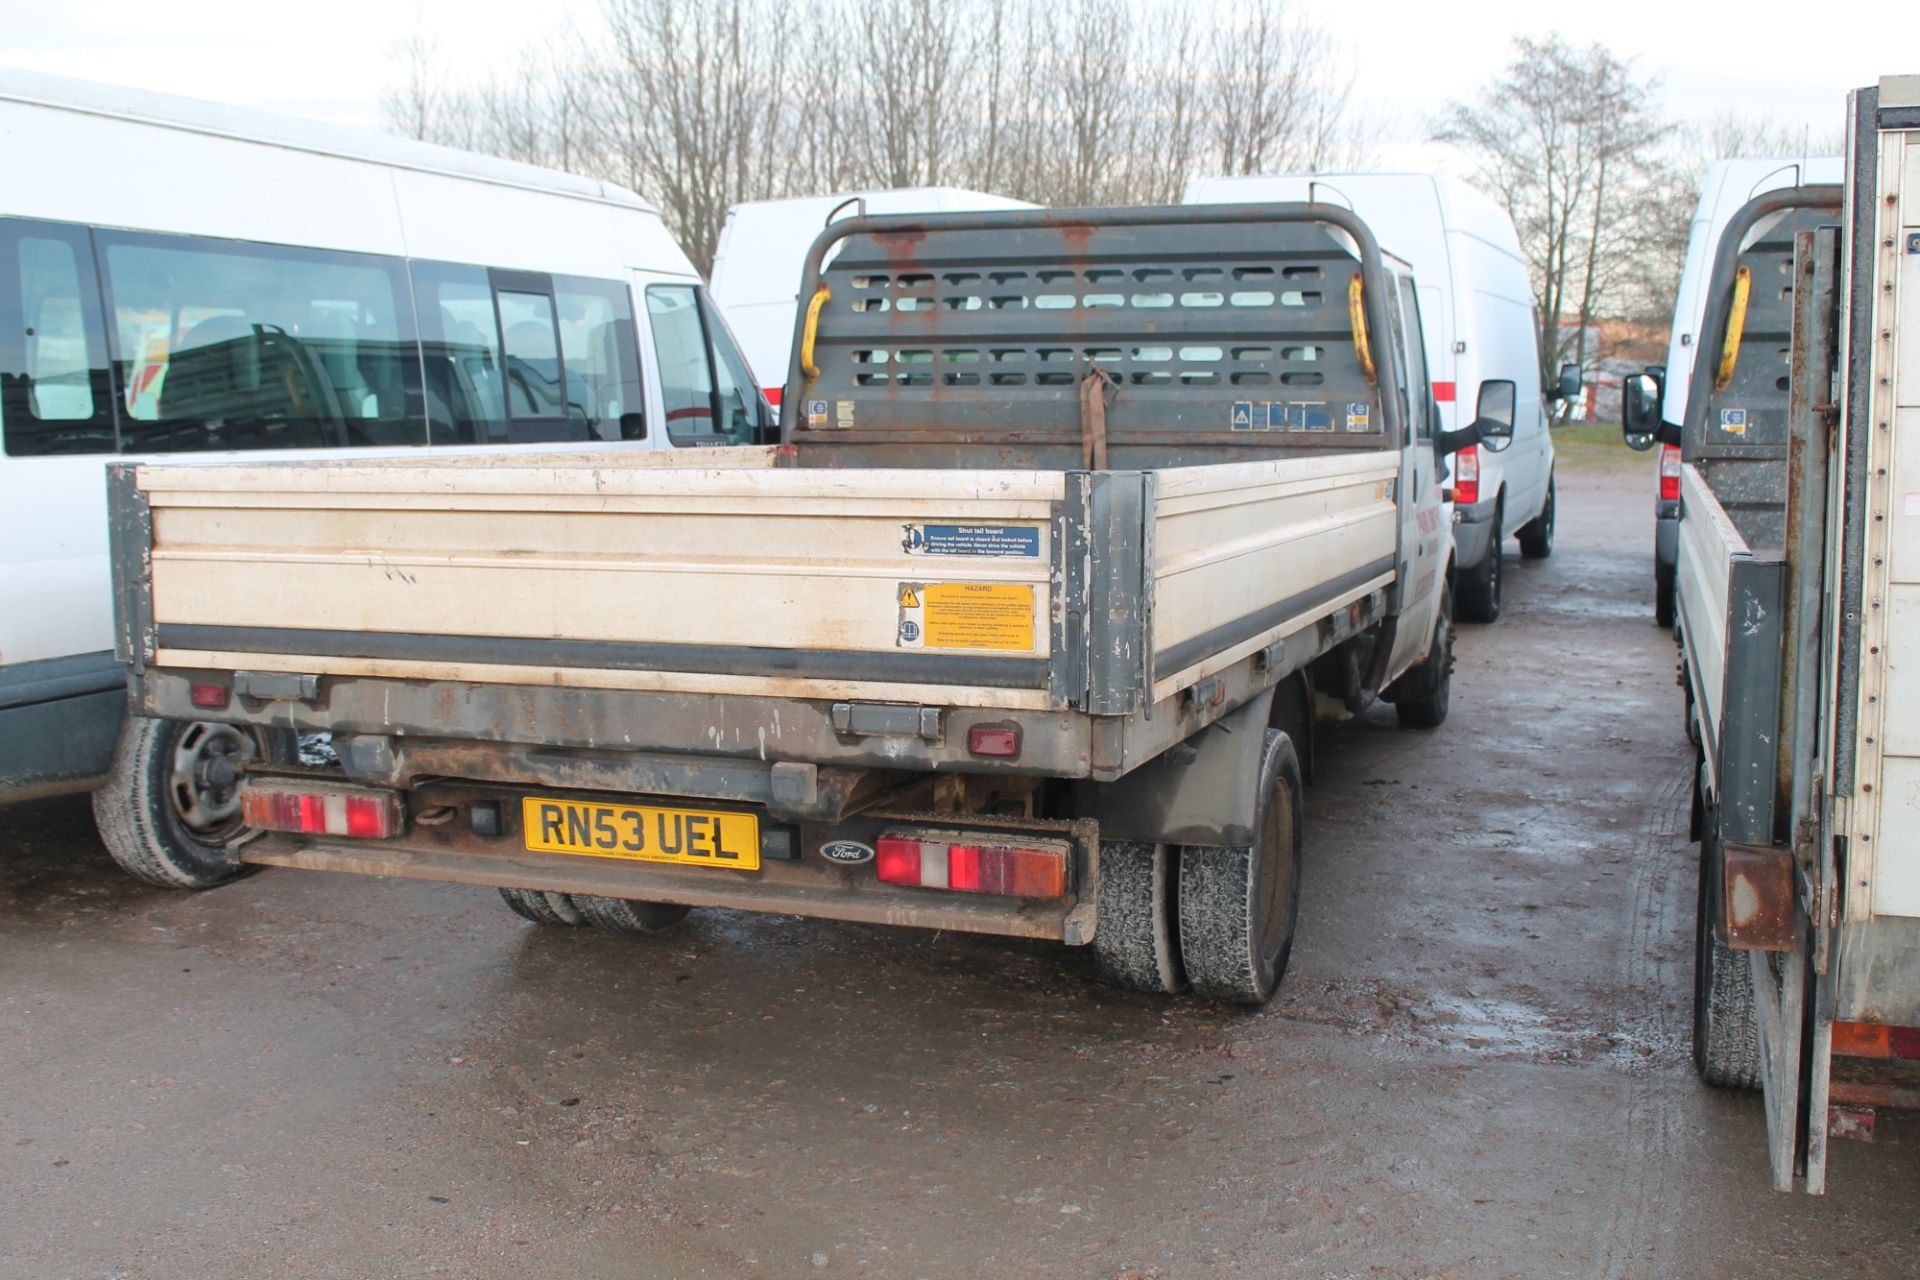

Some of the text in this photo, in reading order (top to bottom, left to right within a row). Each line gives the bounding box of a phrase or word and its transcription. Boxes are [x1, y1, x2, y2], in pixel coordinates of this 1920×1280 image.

[540, 804, 739, 860] RN53 UEL
[832, 844, 861, 859] Ford
